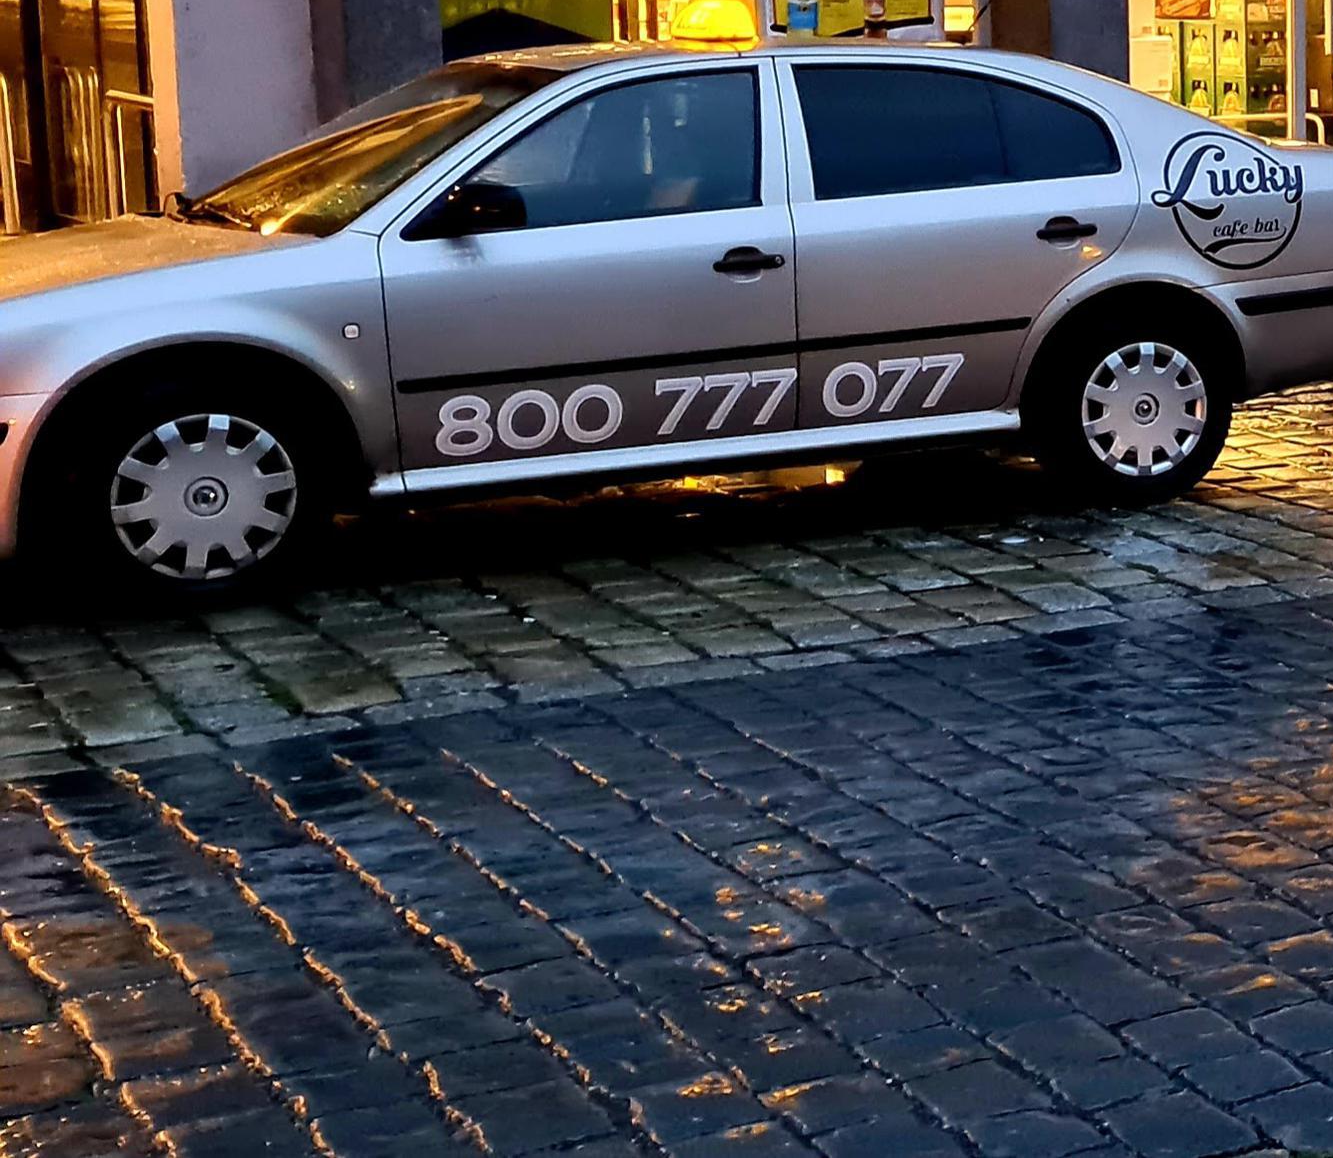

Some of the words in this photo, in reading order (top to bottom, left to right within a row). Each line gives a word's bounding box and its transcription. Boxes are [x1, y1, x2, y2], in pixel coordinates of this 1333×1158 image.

[1151, 144, 1303, 221] Lucky
[1213, 219, 1248, 238] cafe
[1254, 217, 1280, 234] bar
[435, 384, 623, 456] 800
[655, 368, 797, 436] 777
[822, 353, 964, 417] 077
